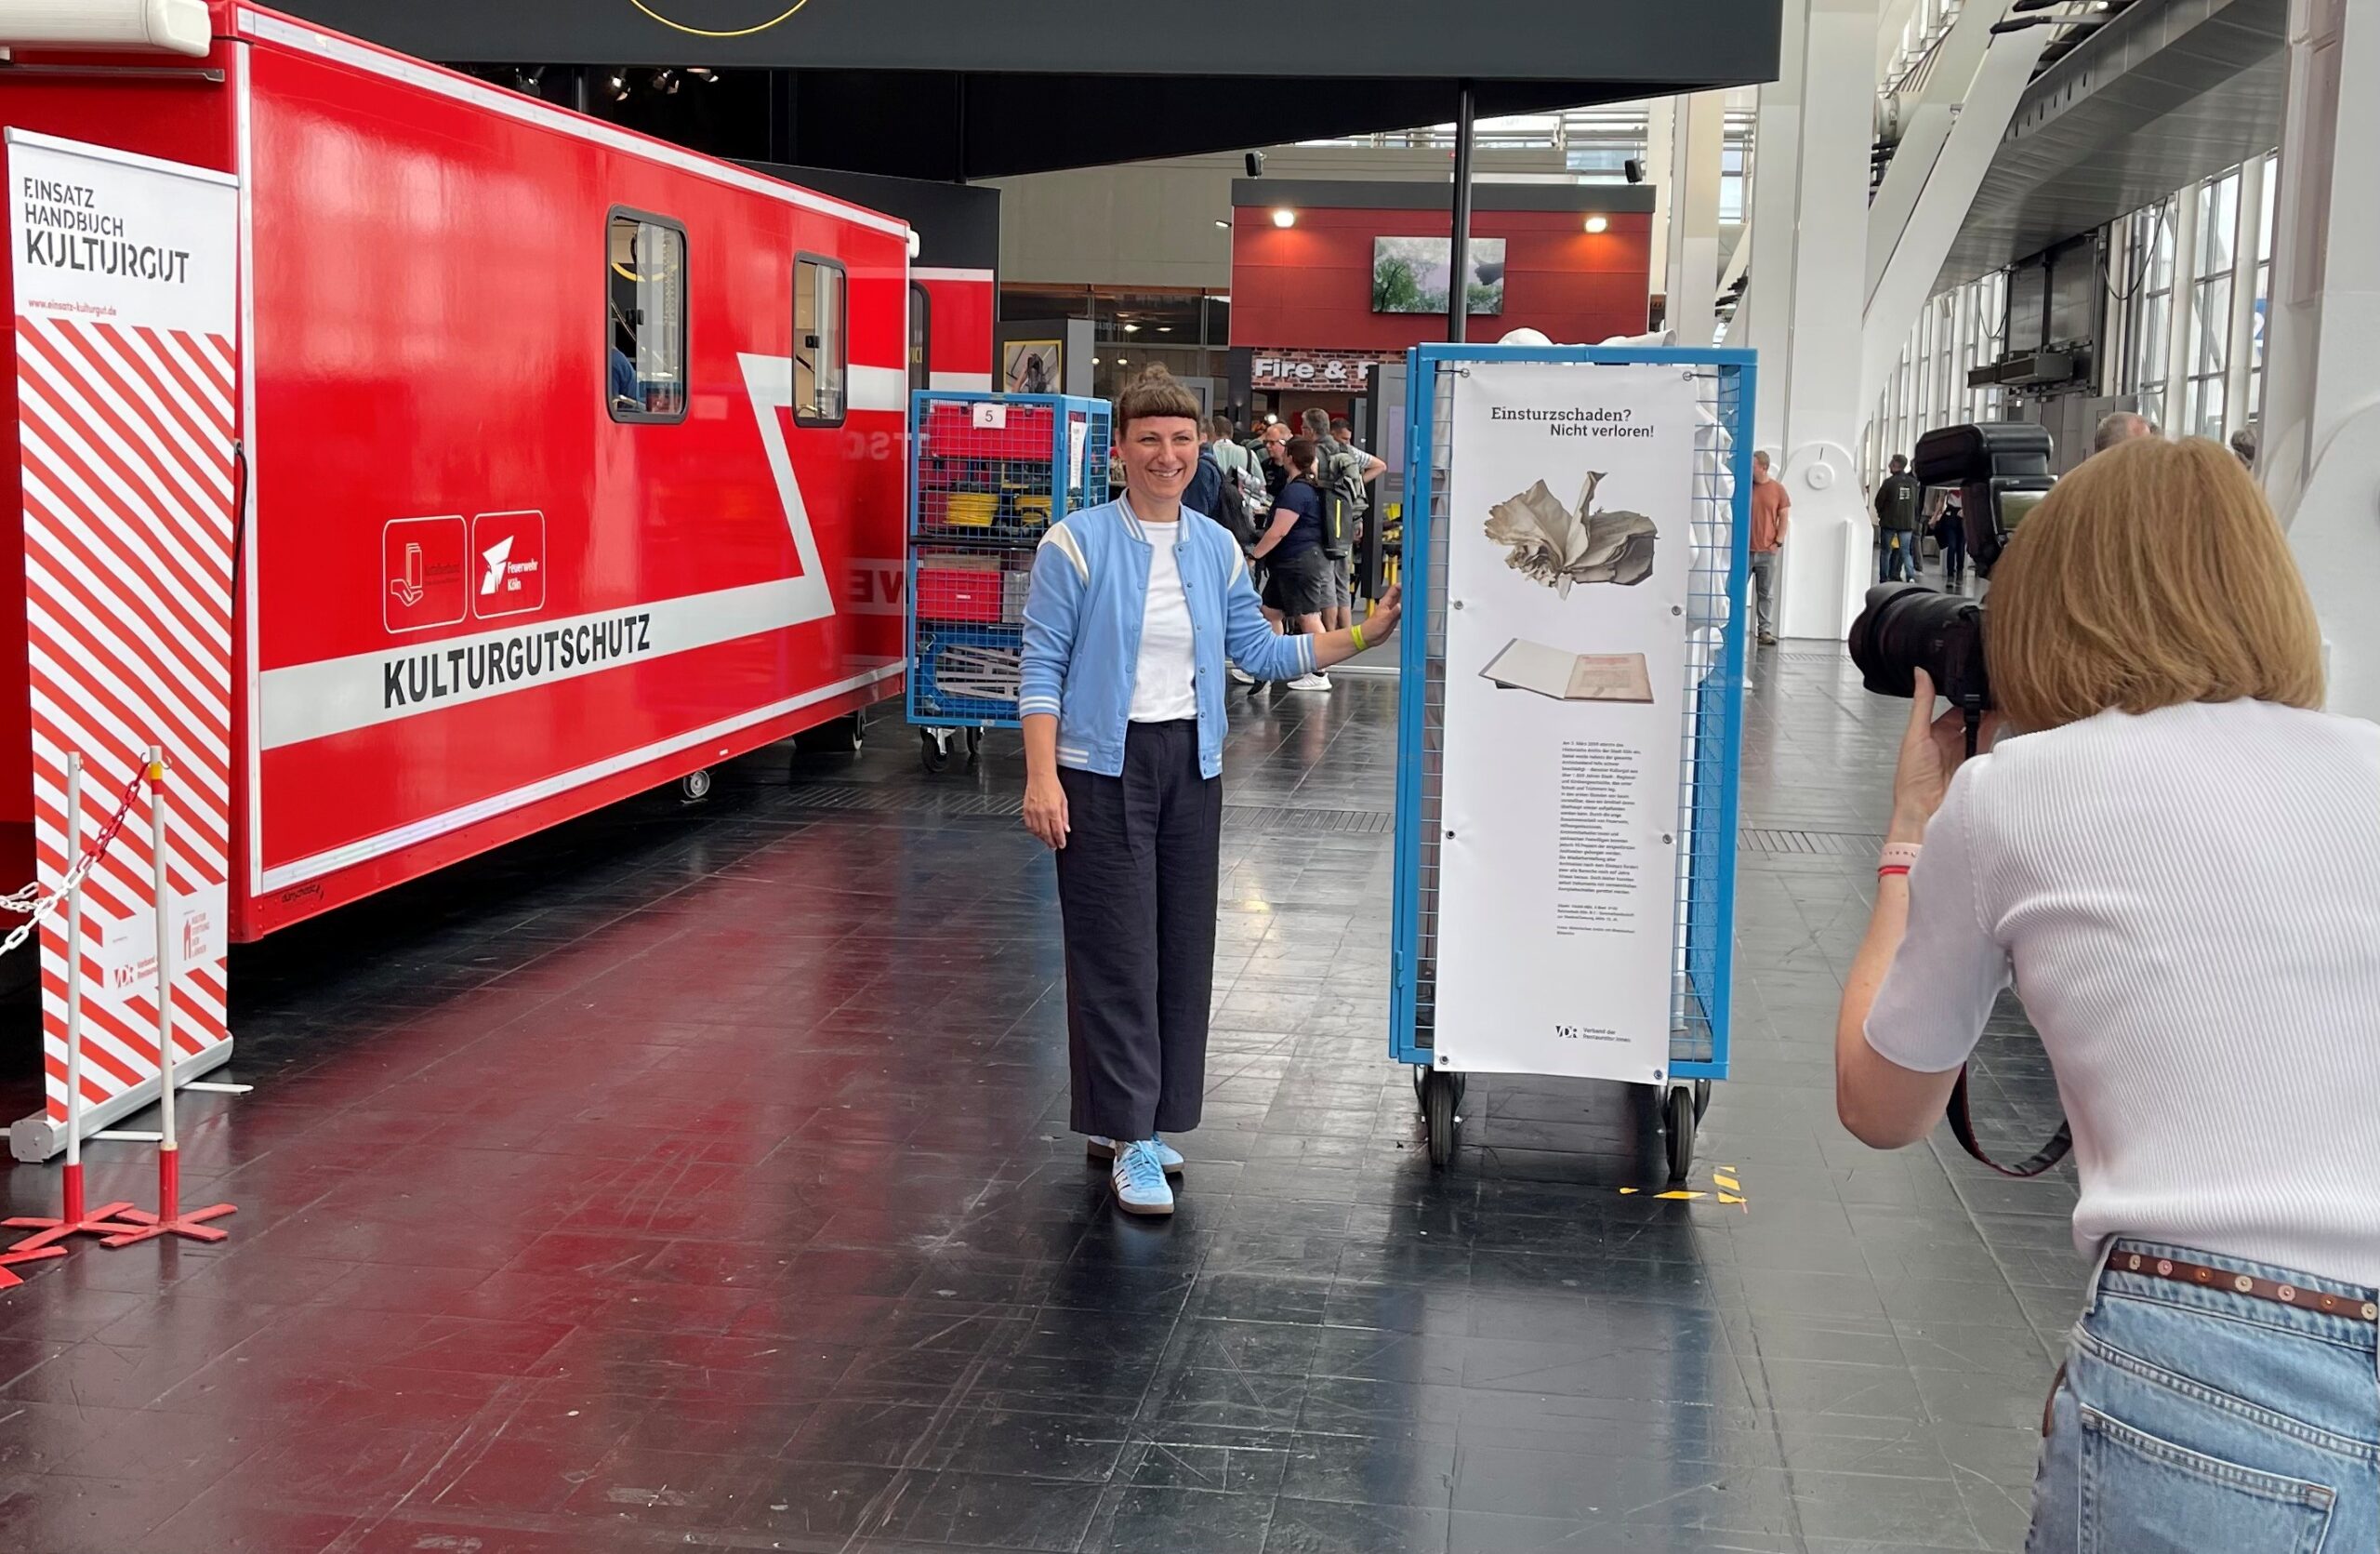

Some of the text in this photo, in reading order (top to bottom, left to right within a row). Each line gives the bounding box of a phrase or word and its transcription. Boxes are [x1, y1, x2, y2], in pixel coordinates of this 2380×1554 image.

[23, 177, 95, 208] EINSATZ
[24, 202, 124, 237] HANDBUCH
[25, 228, 190, 284] KULTURGUT
[1255, 358, 1316, 379] Fire
[1324, 360, 1347, 379] &
[985, 409, 994, 422] 5
[1491, 406, 1632, 421] Einsturzschaden?
[1550, 423, 1655, 437] Nicht verloren!
[508, 558, 538, 574] Feuerwehr
[508, 578, 522, 591] Köln
[384, 613, 651, 709] KULTURGUTSCHUTZ
